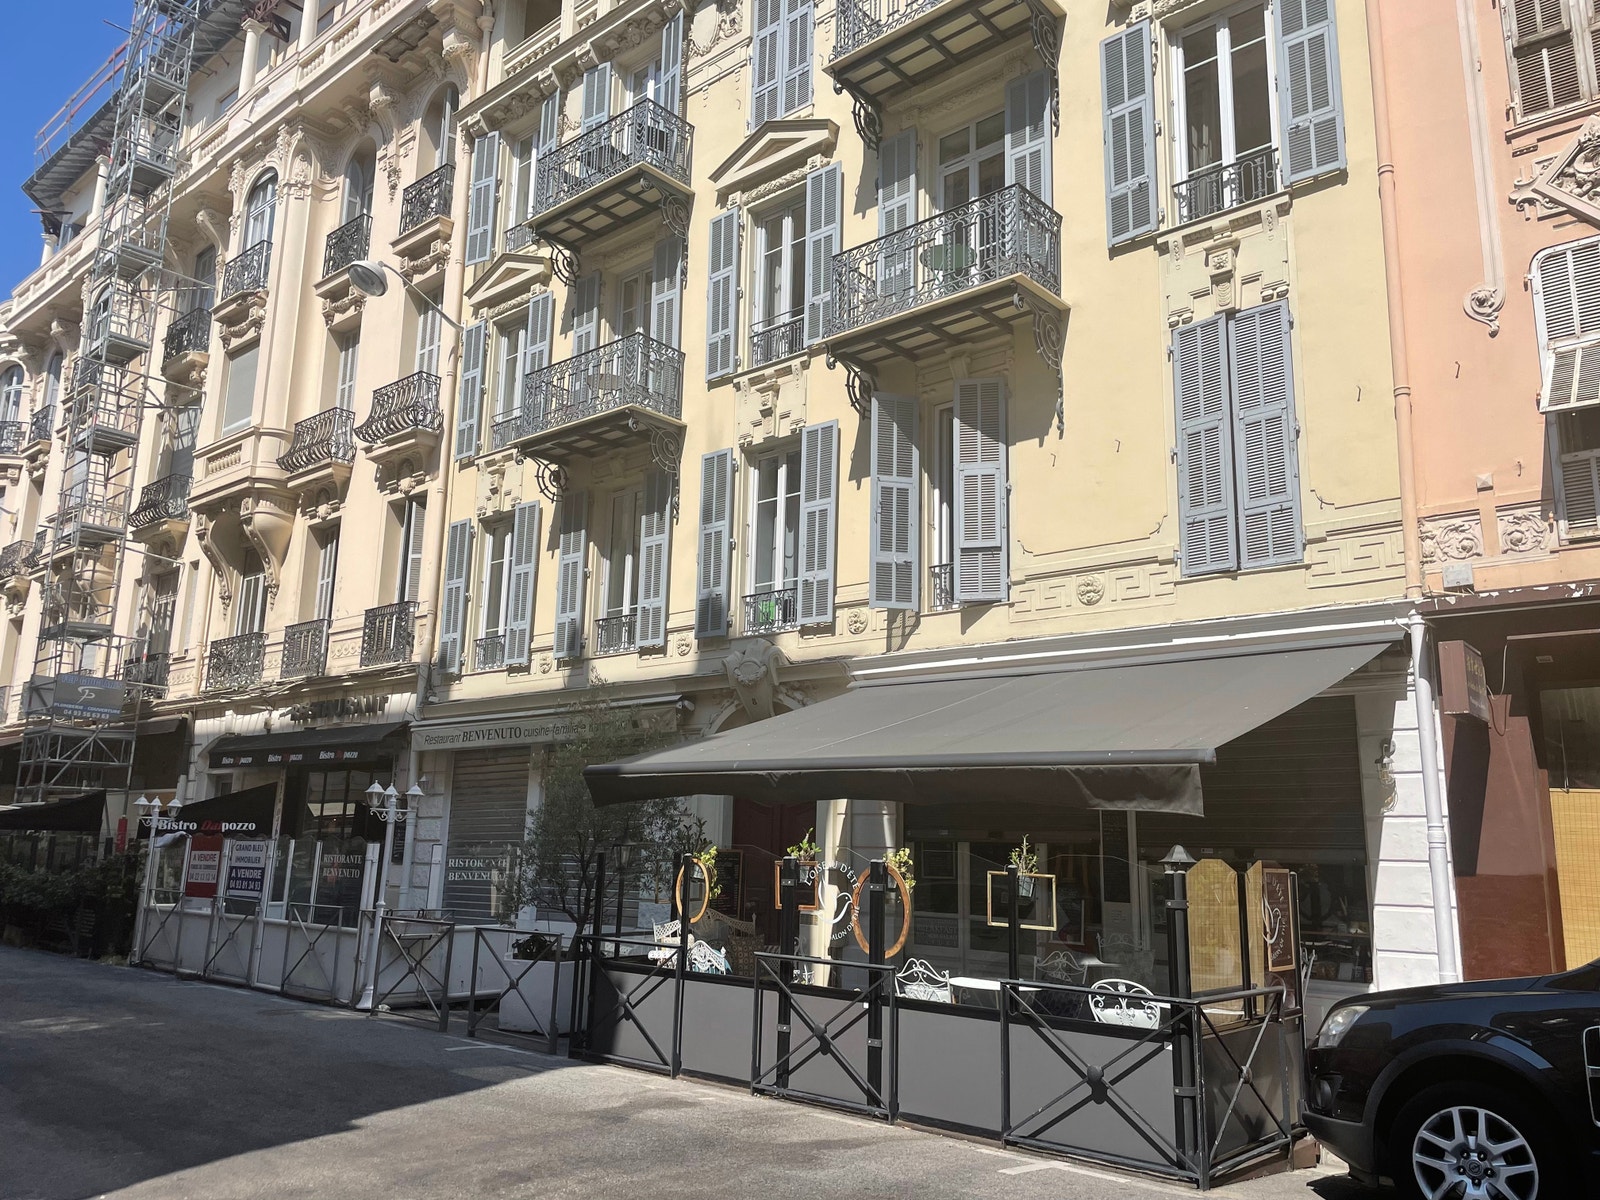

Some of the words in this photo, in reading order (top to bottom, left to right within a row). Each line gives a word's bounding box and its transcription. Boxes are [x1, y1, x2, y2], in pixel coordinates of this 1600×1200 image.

[423, 734, 461, 745] Restaurant
[461, 726, 522, 743] BENVENUTO
[523, 727, 550, 738] cuisine
[157, 820, 198, 831] Bistro
[197, 853, 217, 862] VENDRE
[323, 854, 363, 864] RISTORANTE
[231, 869, 236, 878] A
[237, 869, 262, 879] VENDRE
[322, 867, 360, 878] BENVENUTO
[831, 928, 847, 940] ALON
